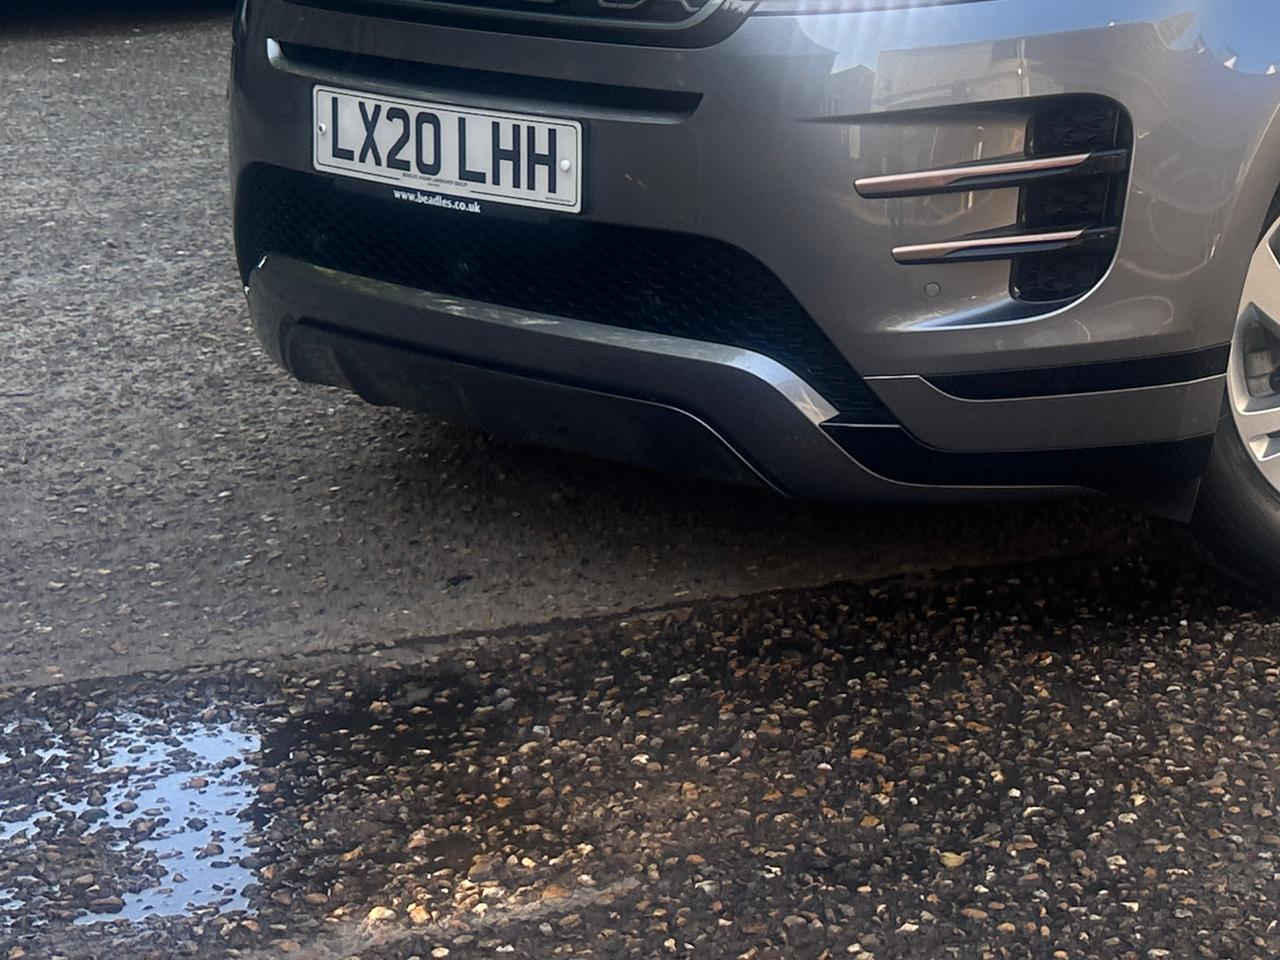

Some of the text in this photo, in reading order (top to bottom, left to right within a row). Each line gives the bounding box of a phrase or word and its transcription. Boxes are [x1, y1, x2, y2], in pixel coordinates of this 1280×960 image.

[331, 96, 557, 194] LX20 LHH
[393, 189, 481, 213] www.beadles.co.uk
